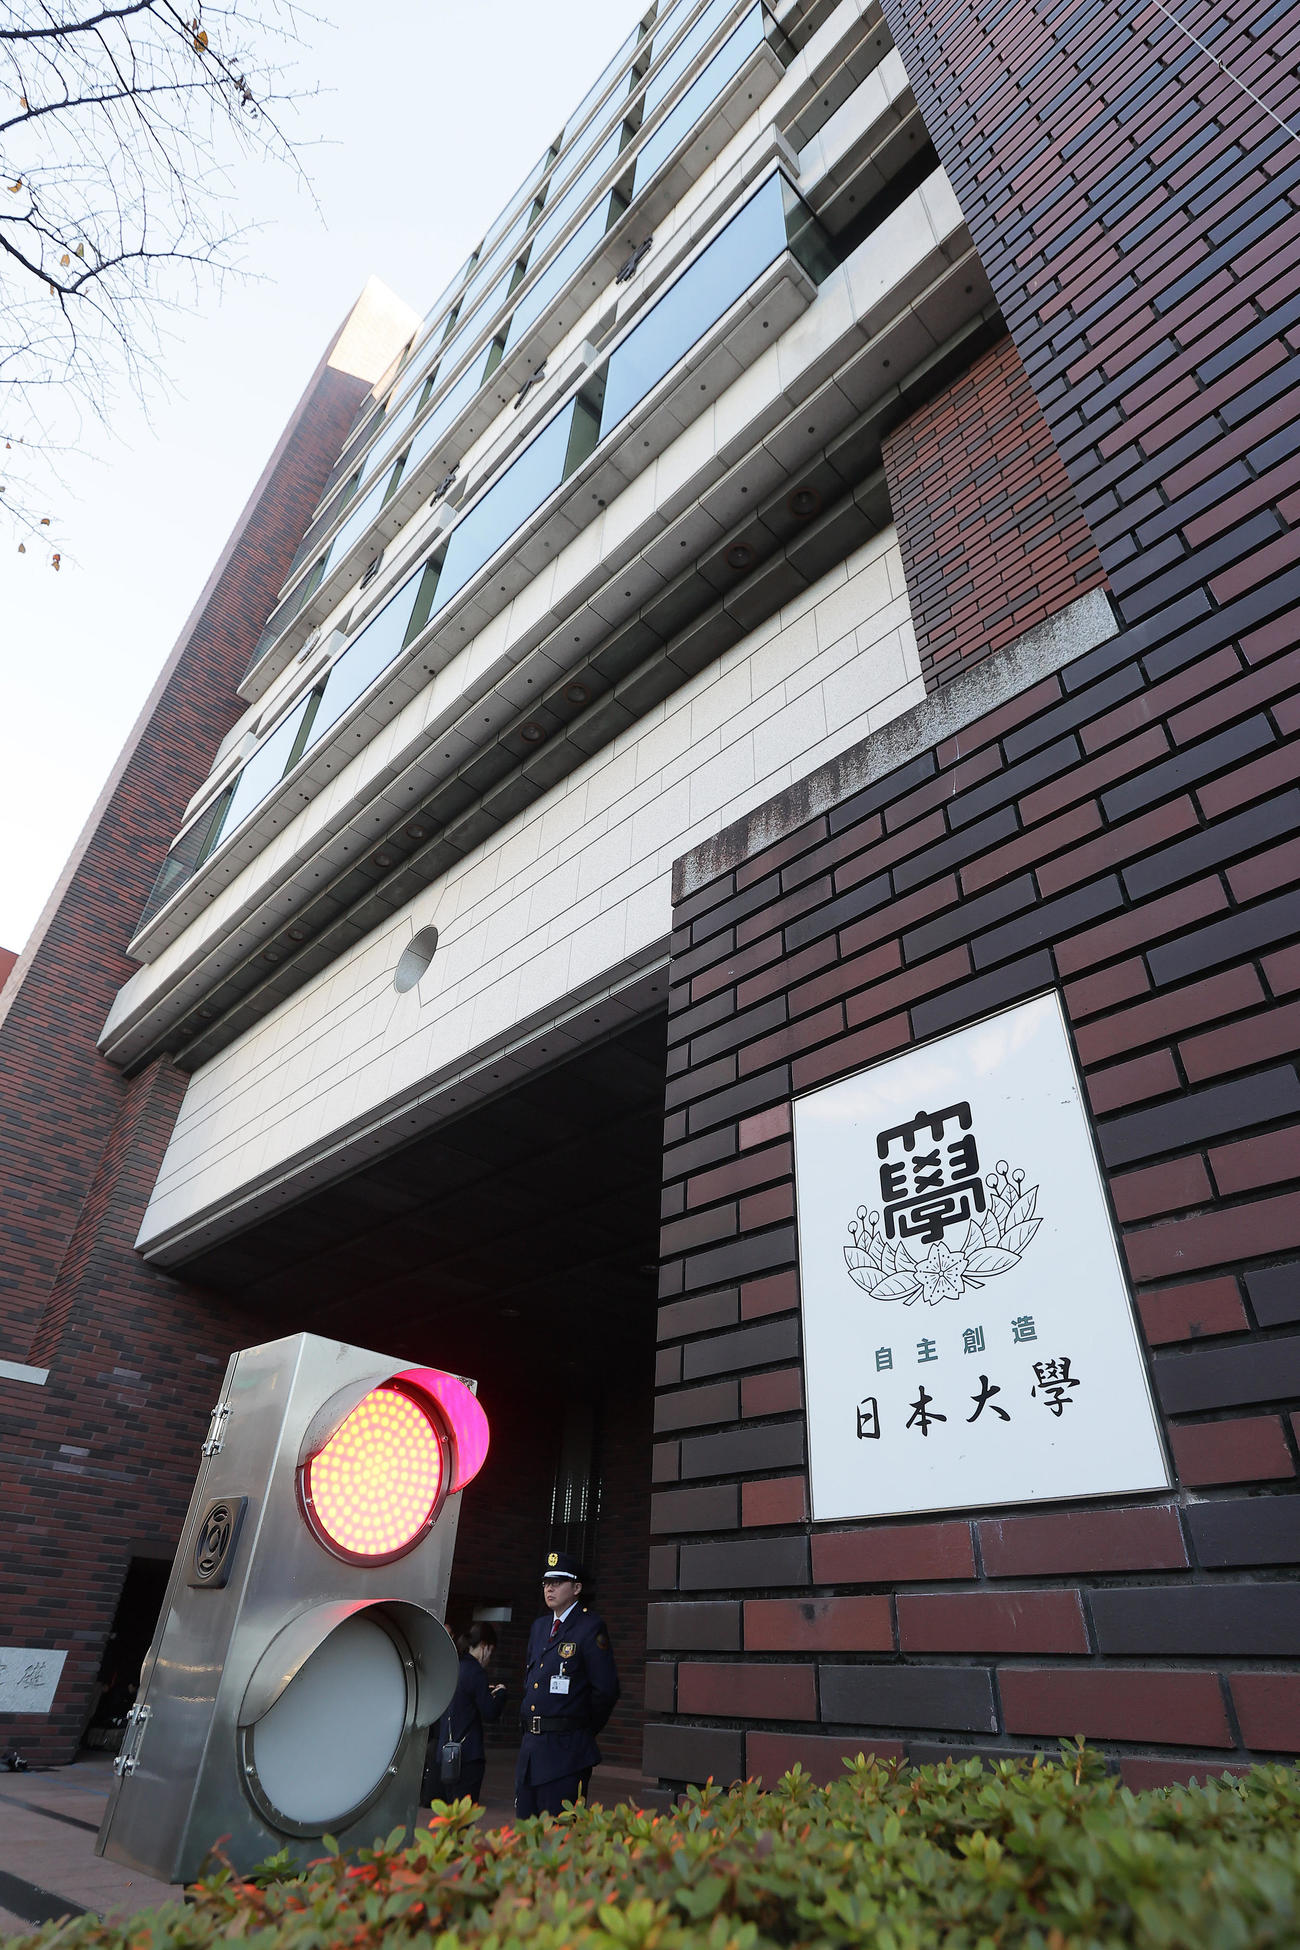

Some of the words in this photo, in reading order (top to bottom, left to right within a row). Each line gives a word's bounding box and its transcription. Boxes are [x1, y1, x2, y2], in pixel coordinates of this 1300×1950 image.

[874, 1315, 1039, 1373] 自主創造
[855, 1357, 1081, 1441] 日本大學
[0, 1661, 46, 1689] 礎
